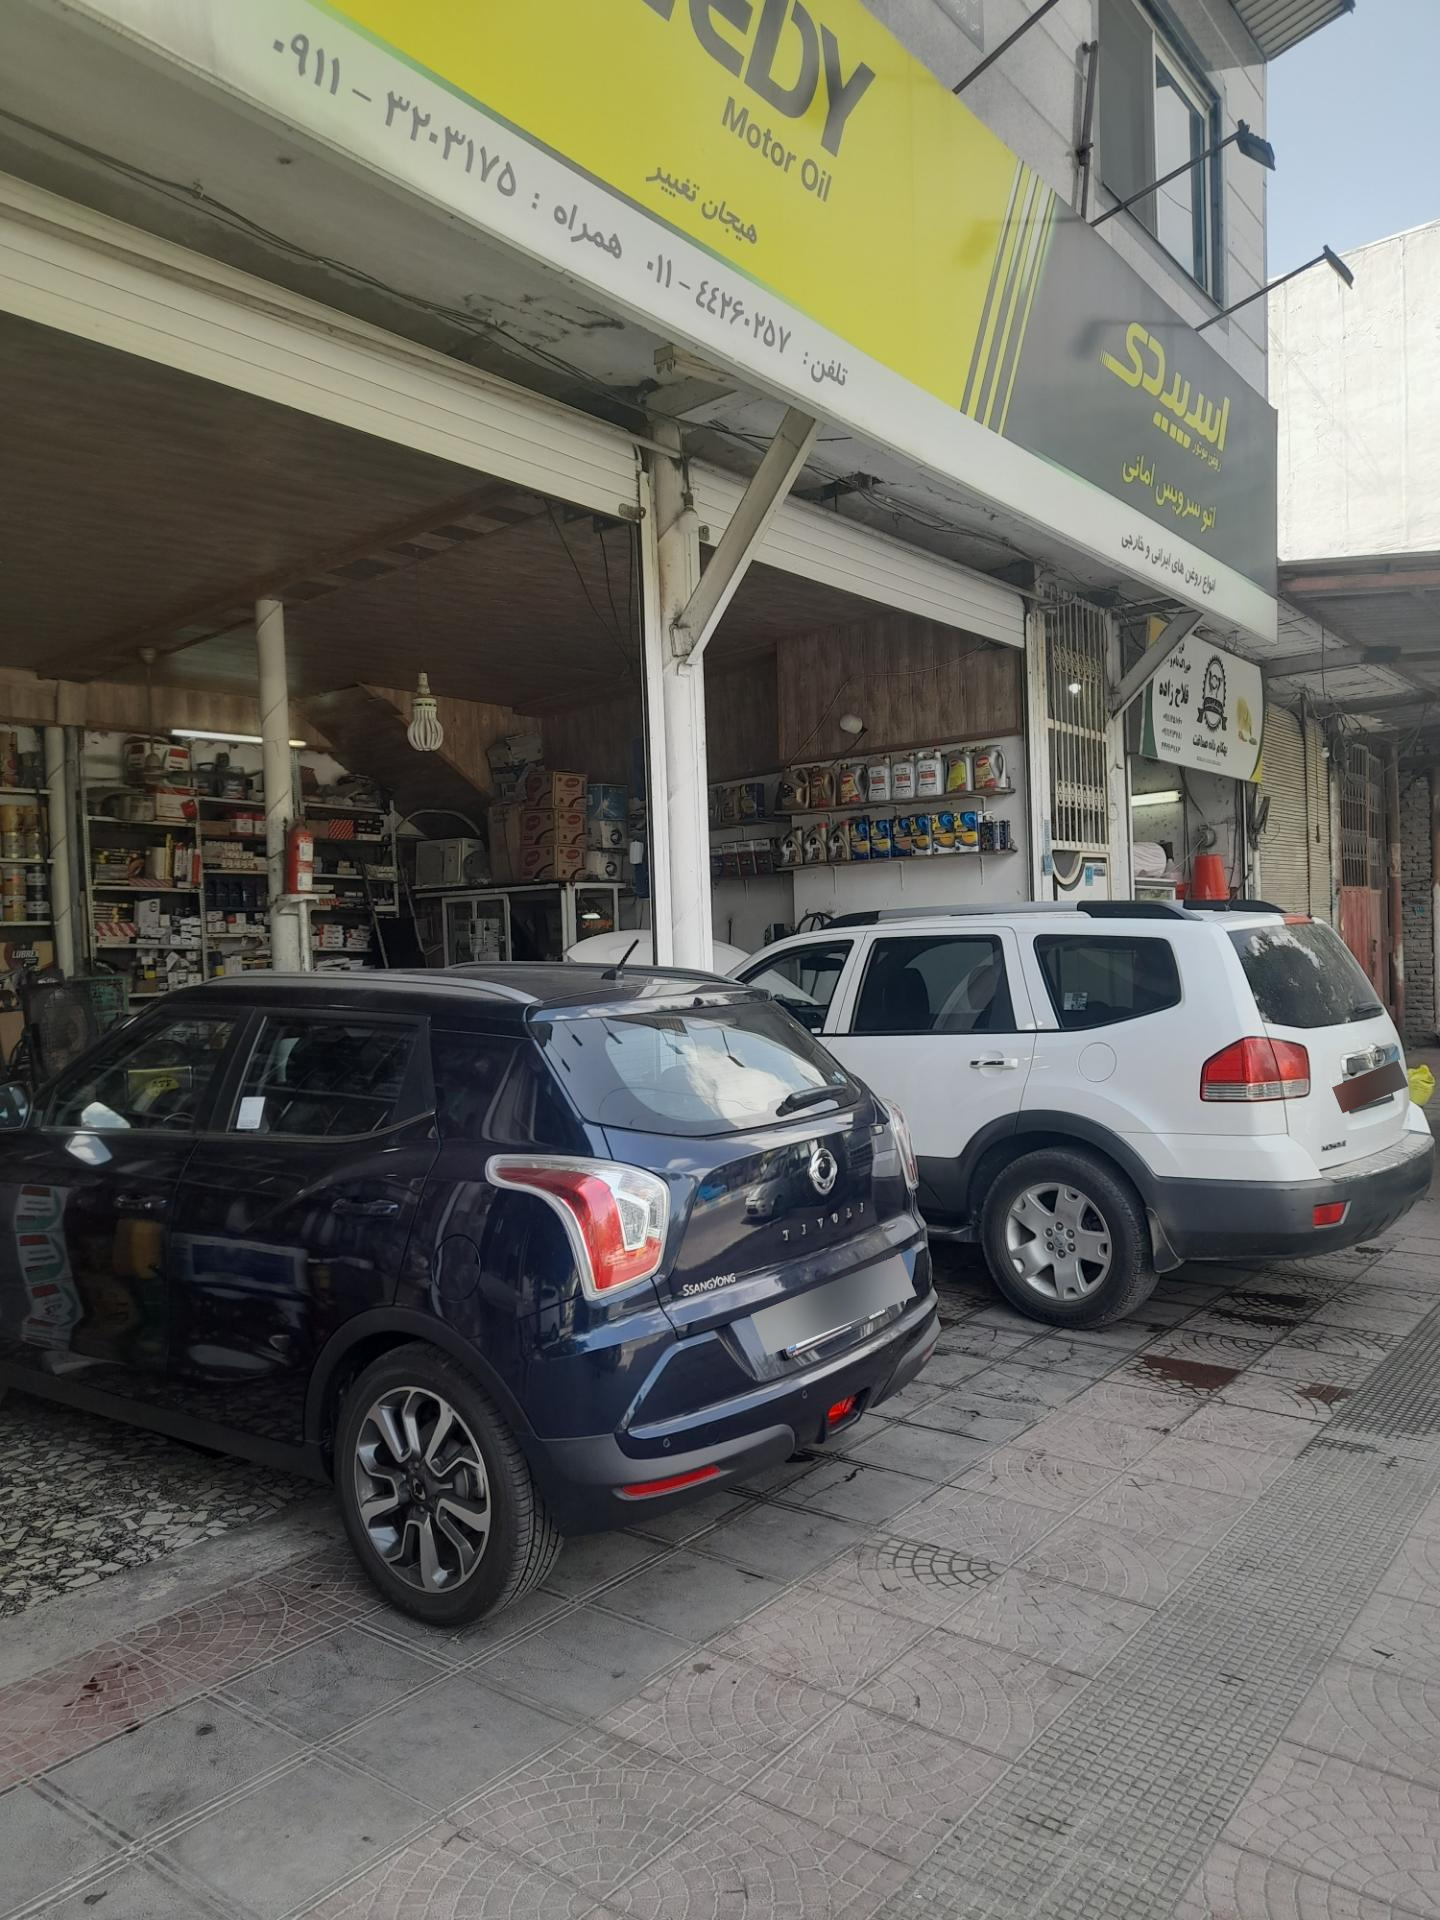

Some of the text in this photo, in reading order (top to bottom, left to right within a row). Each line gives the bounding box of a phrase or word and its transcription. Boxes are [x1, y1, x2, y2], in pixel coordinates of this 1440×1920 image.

[643, 0, 876, 157] EDY
[722, 96, 832, 202] Motor Oil
[646, 167, 758, 245] هیجان تغییر
[1100, 322, 1230, 451] اسپیدی
[1122, 455, 1216, 532] اتو سرویس امانی
[1151, 547, 1170, 570] ایرانی
[1172, 557, 1184, 574] های
[1185, 567, 1202, 587] روغن
